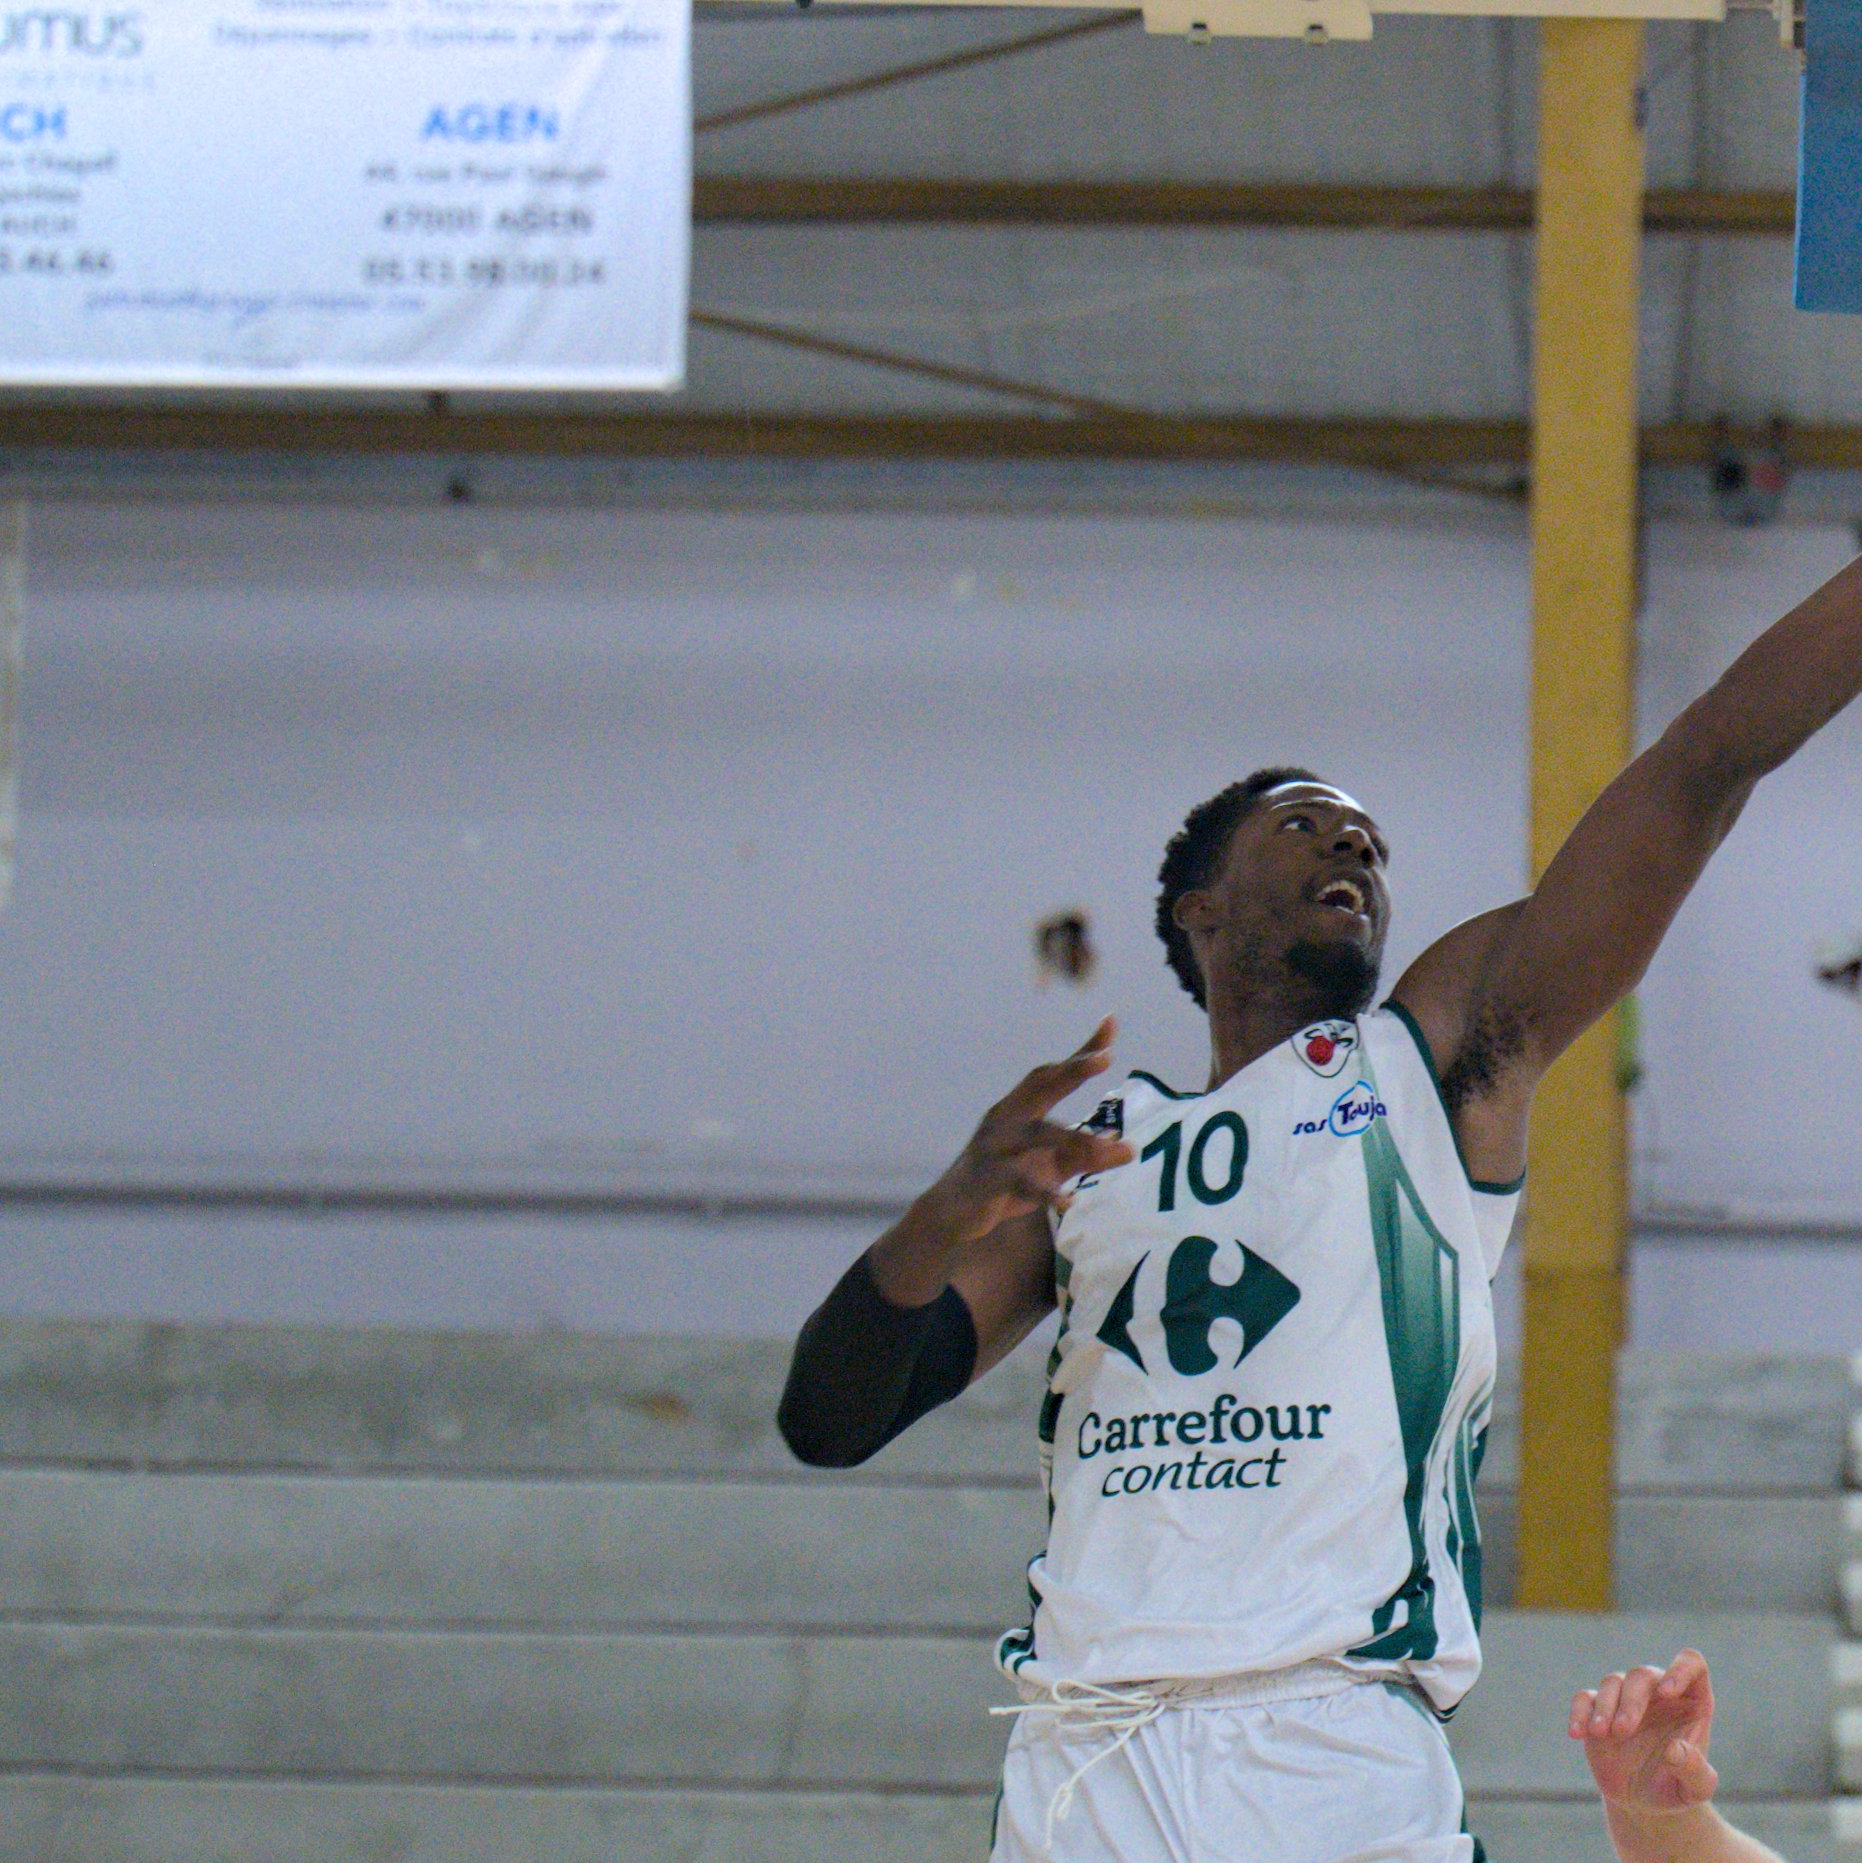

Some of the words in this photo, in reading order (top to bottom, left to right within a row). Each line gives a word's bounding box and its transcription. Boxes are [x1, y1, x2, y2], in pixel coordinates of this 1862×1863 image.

[422, 102, 560, 143] AGEN
[1140, 1110, 1249, 1213] 10
[1077, 1393, 1332, 1460] Carrefour
[1101, 1447, 1287, 1499] contact
